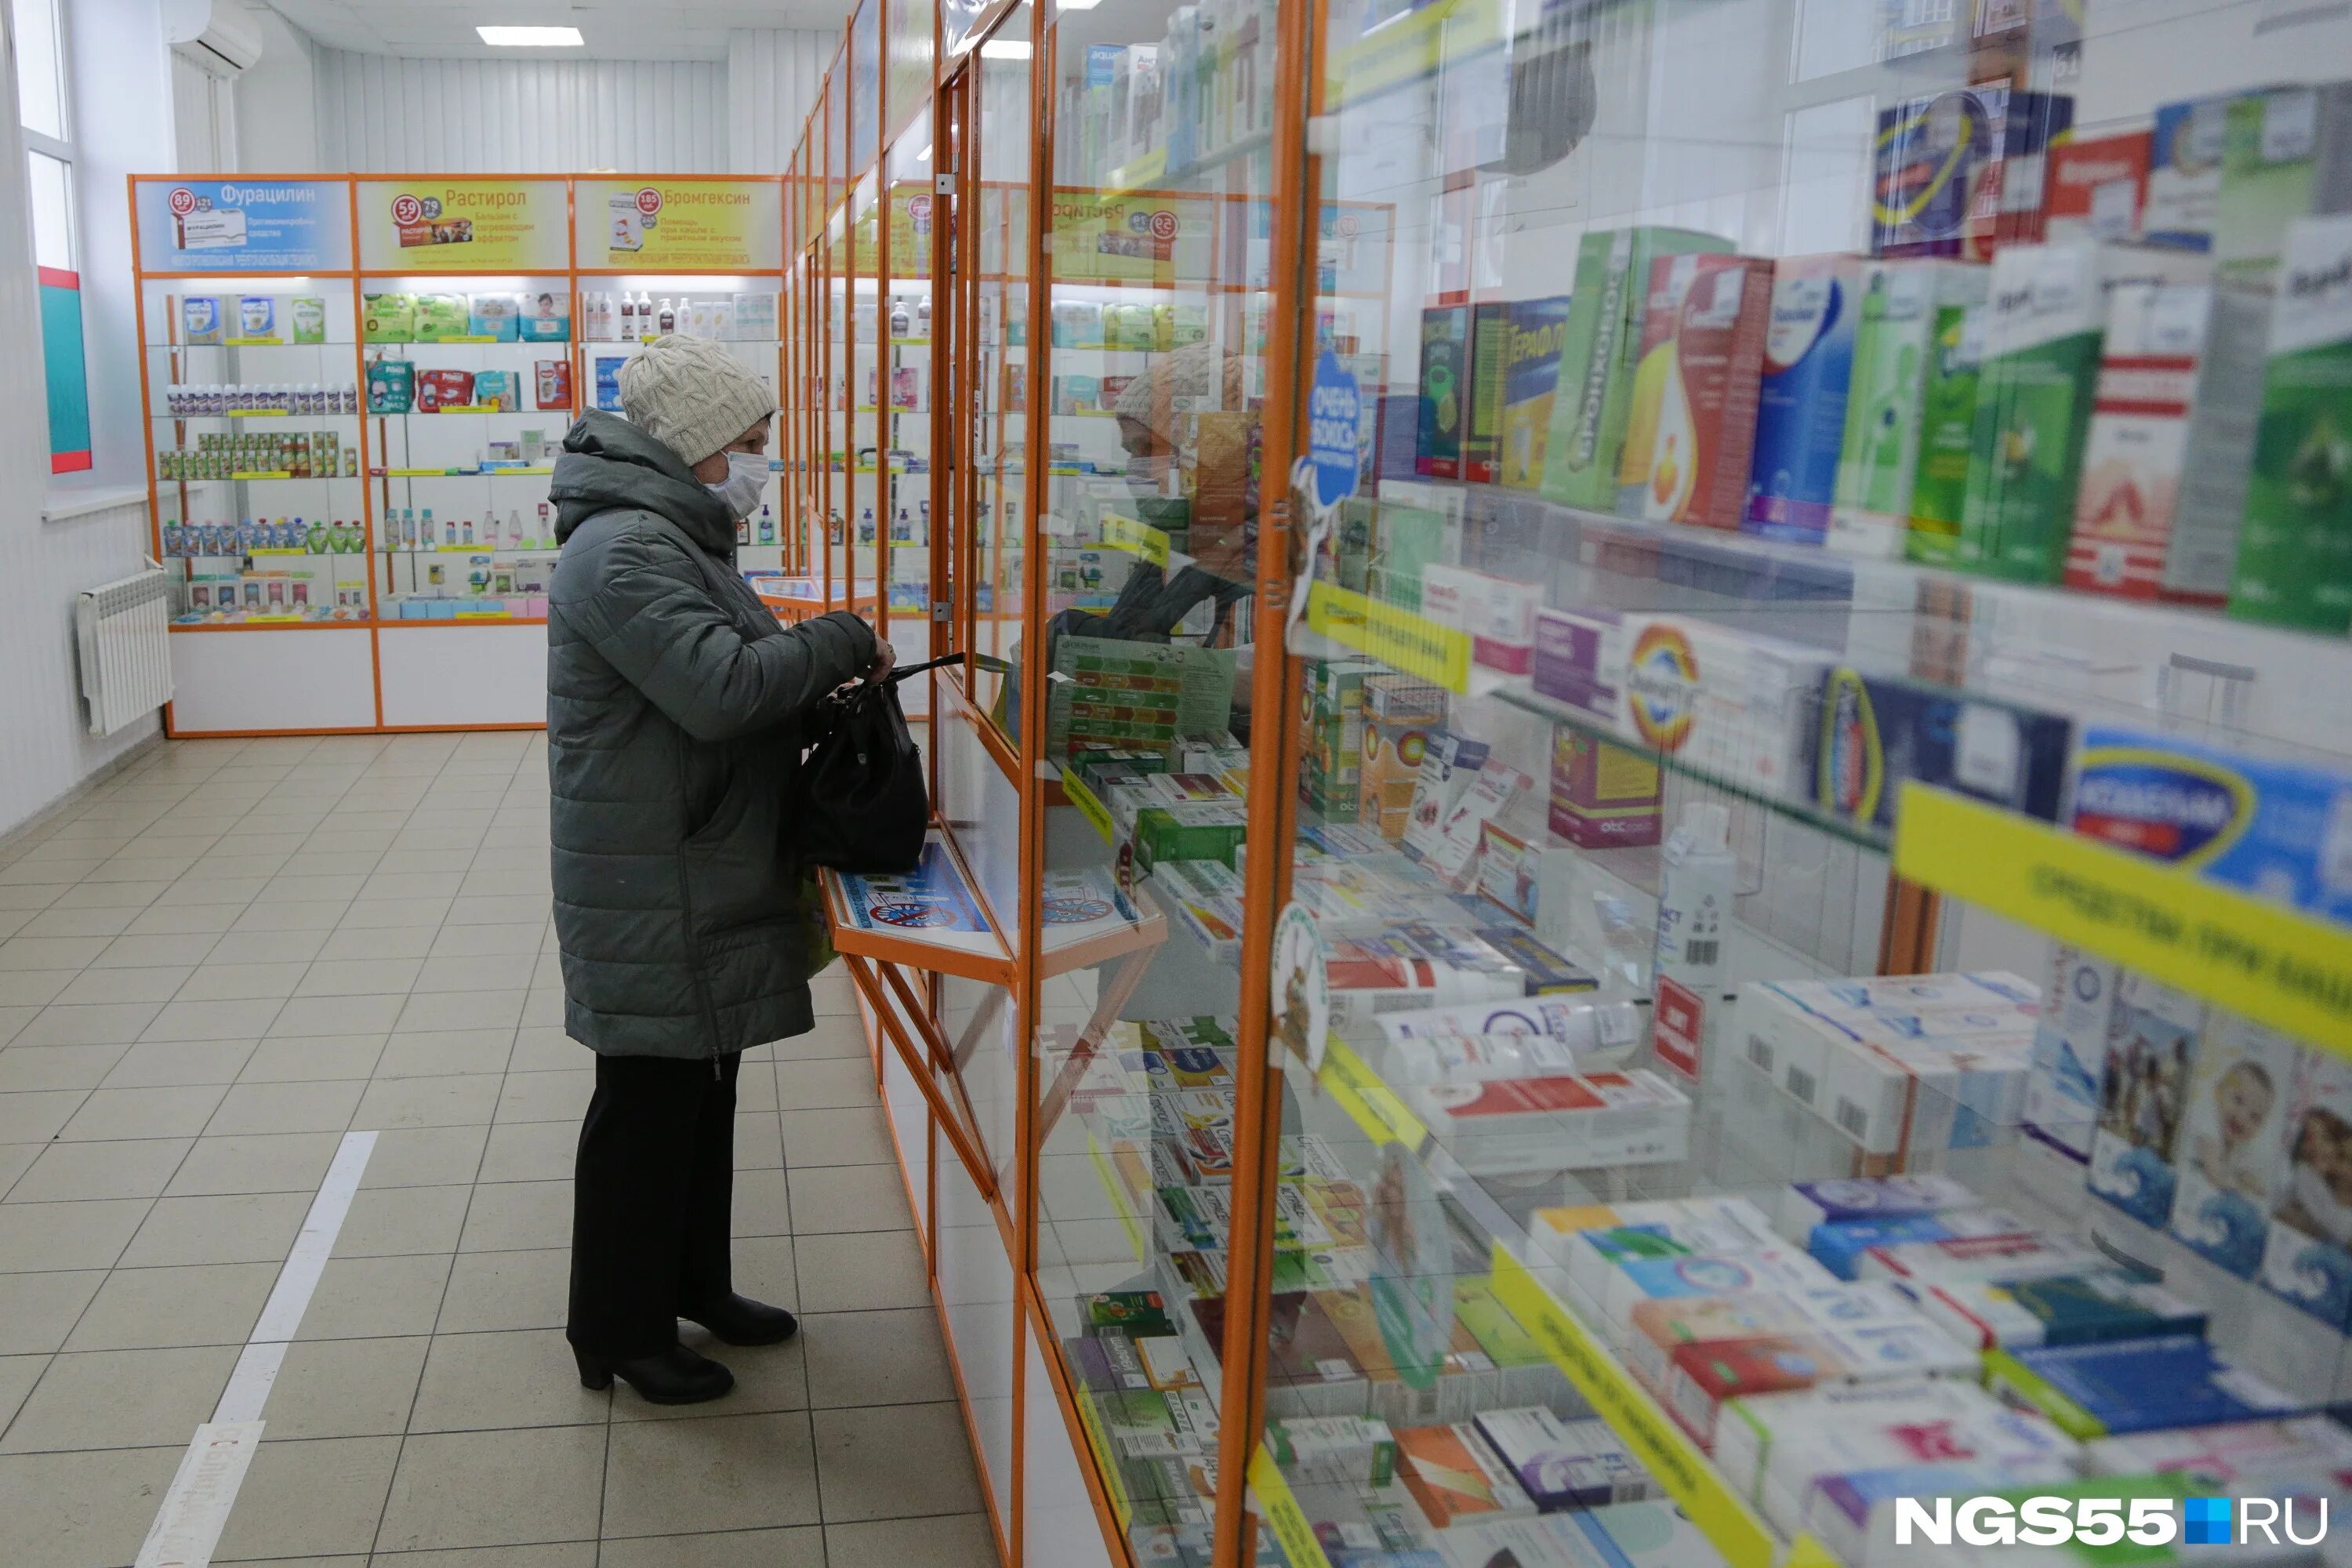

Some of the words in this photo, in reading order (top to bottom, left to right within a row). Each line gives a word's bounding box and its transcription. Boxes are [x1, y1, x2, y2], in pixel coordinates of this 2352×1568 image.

[174, 194, 191, 206] 89
[220, 184, 315, 206] Фурацилин
[445, 189, 527, 209] Растирол
[664, 190, 750, 206] Бромгексин
[398, 201, 417, 215] 59
